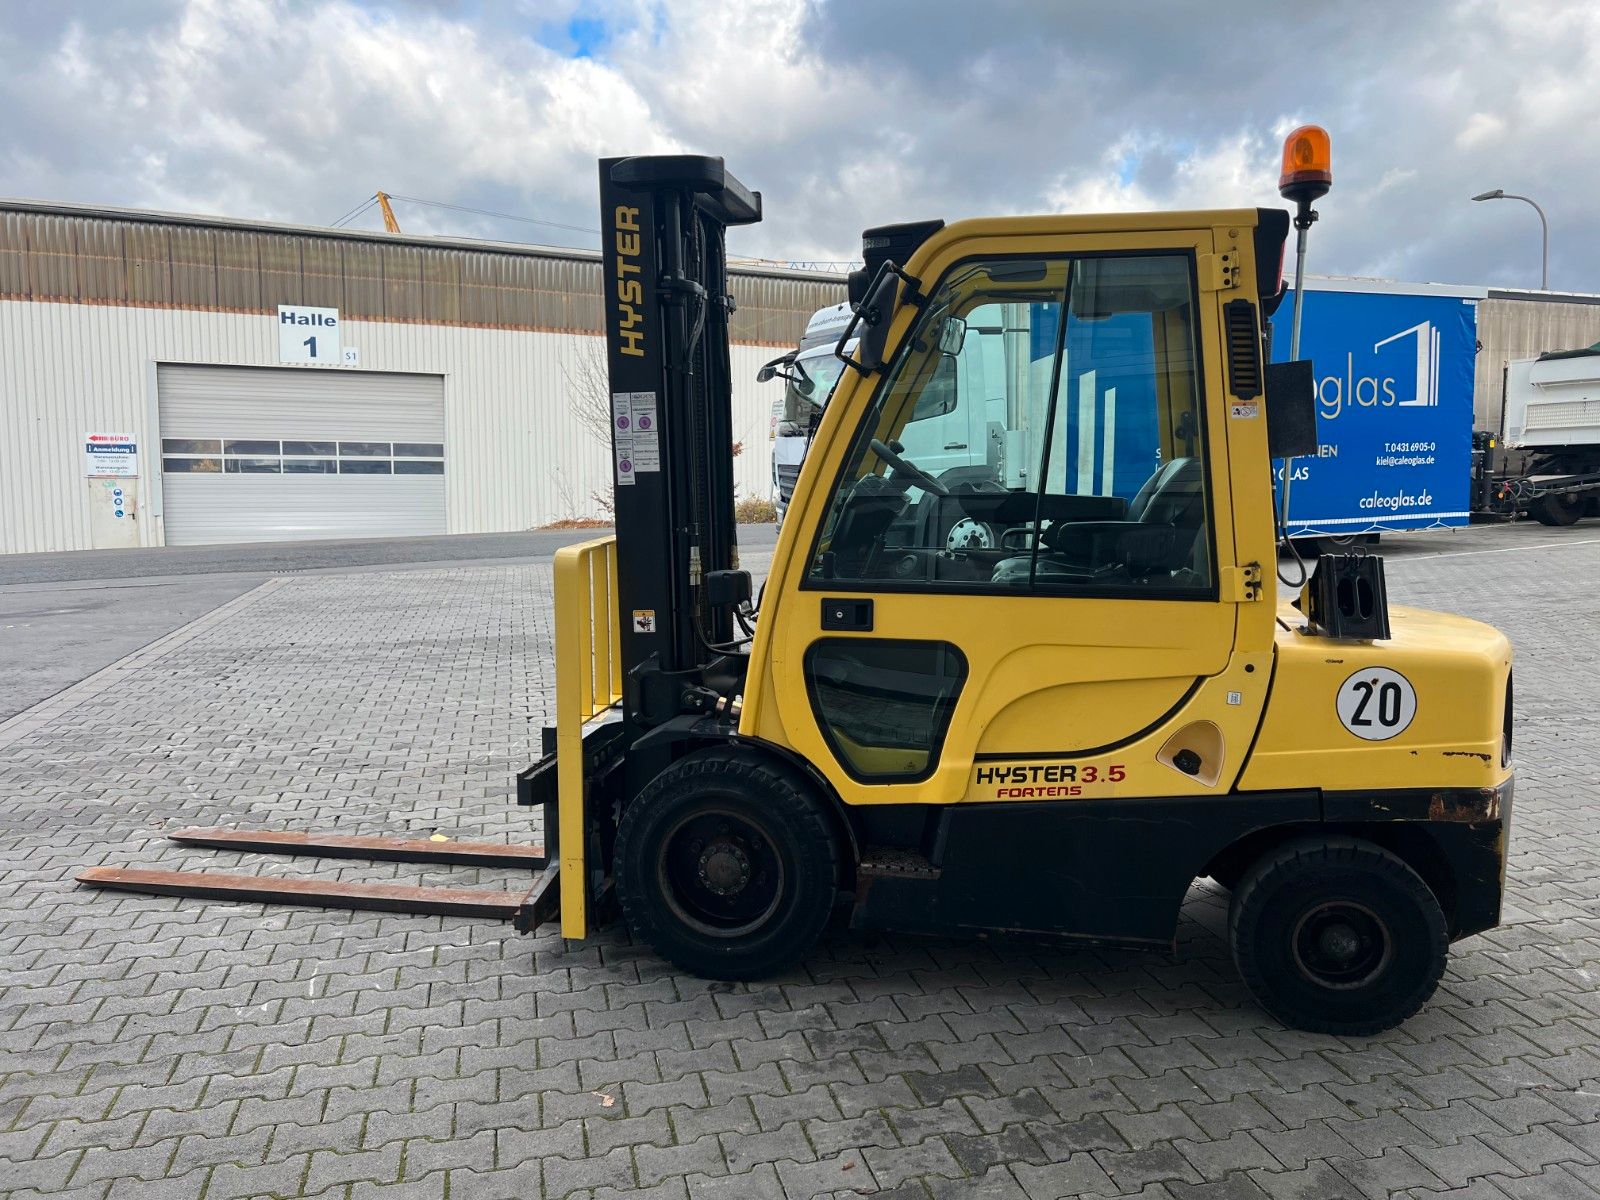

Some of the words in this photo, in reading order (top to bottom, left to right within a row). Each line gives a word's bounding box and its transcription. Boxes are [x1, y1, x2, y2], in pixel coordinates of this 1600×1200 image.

[615, 205, 645, 357] HYSTER
[281, 311, 337, 327] Halle
[303, 336, 317, 358] 1
[1411, 442, 1436, 452] 6905-0
[1376, 455, 1435, 467] kiel@caleoglas.de
[1359, 489, 1433, 511] caleoglas.de
[1351, 681, 1402, 727] 20
[976, 765, 1077, 784] HYSTER
[1081, 765, 1126, 783] 3.5
[997, 786, 1082, 798] FORTENS
